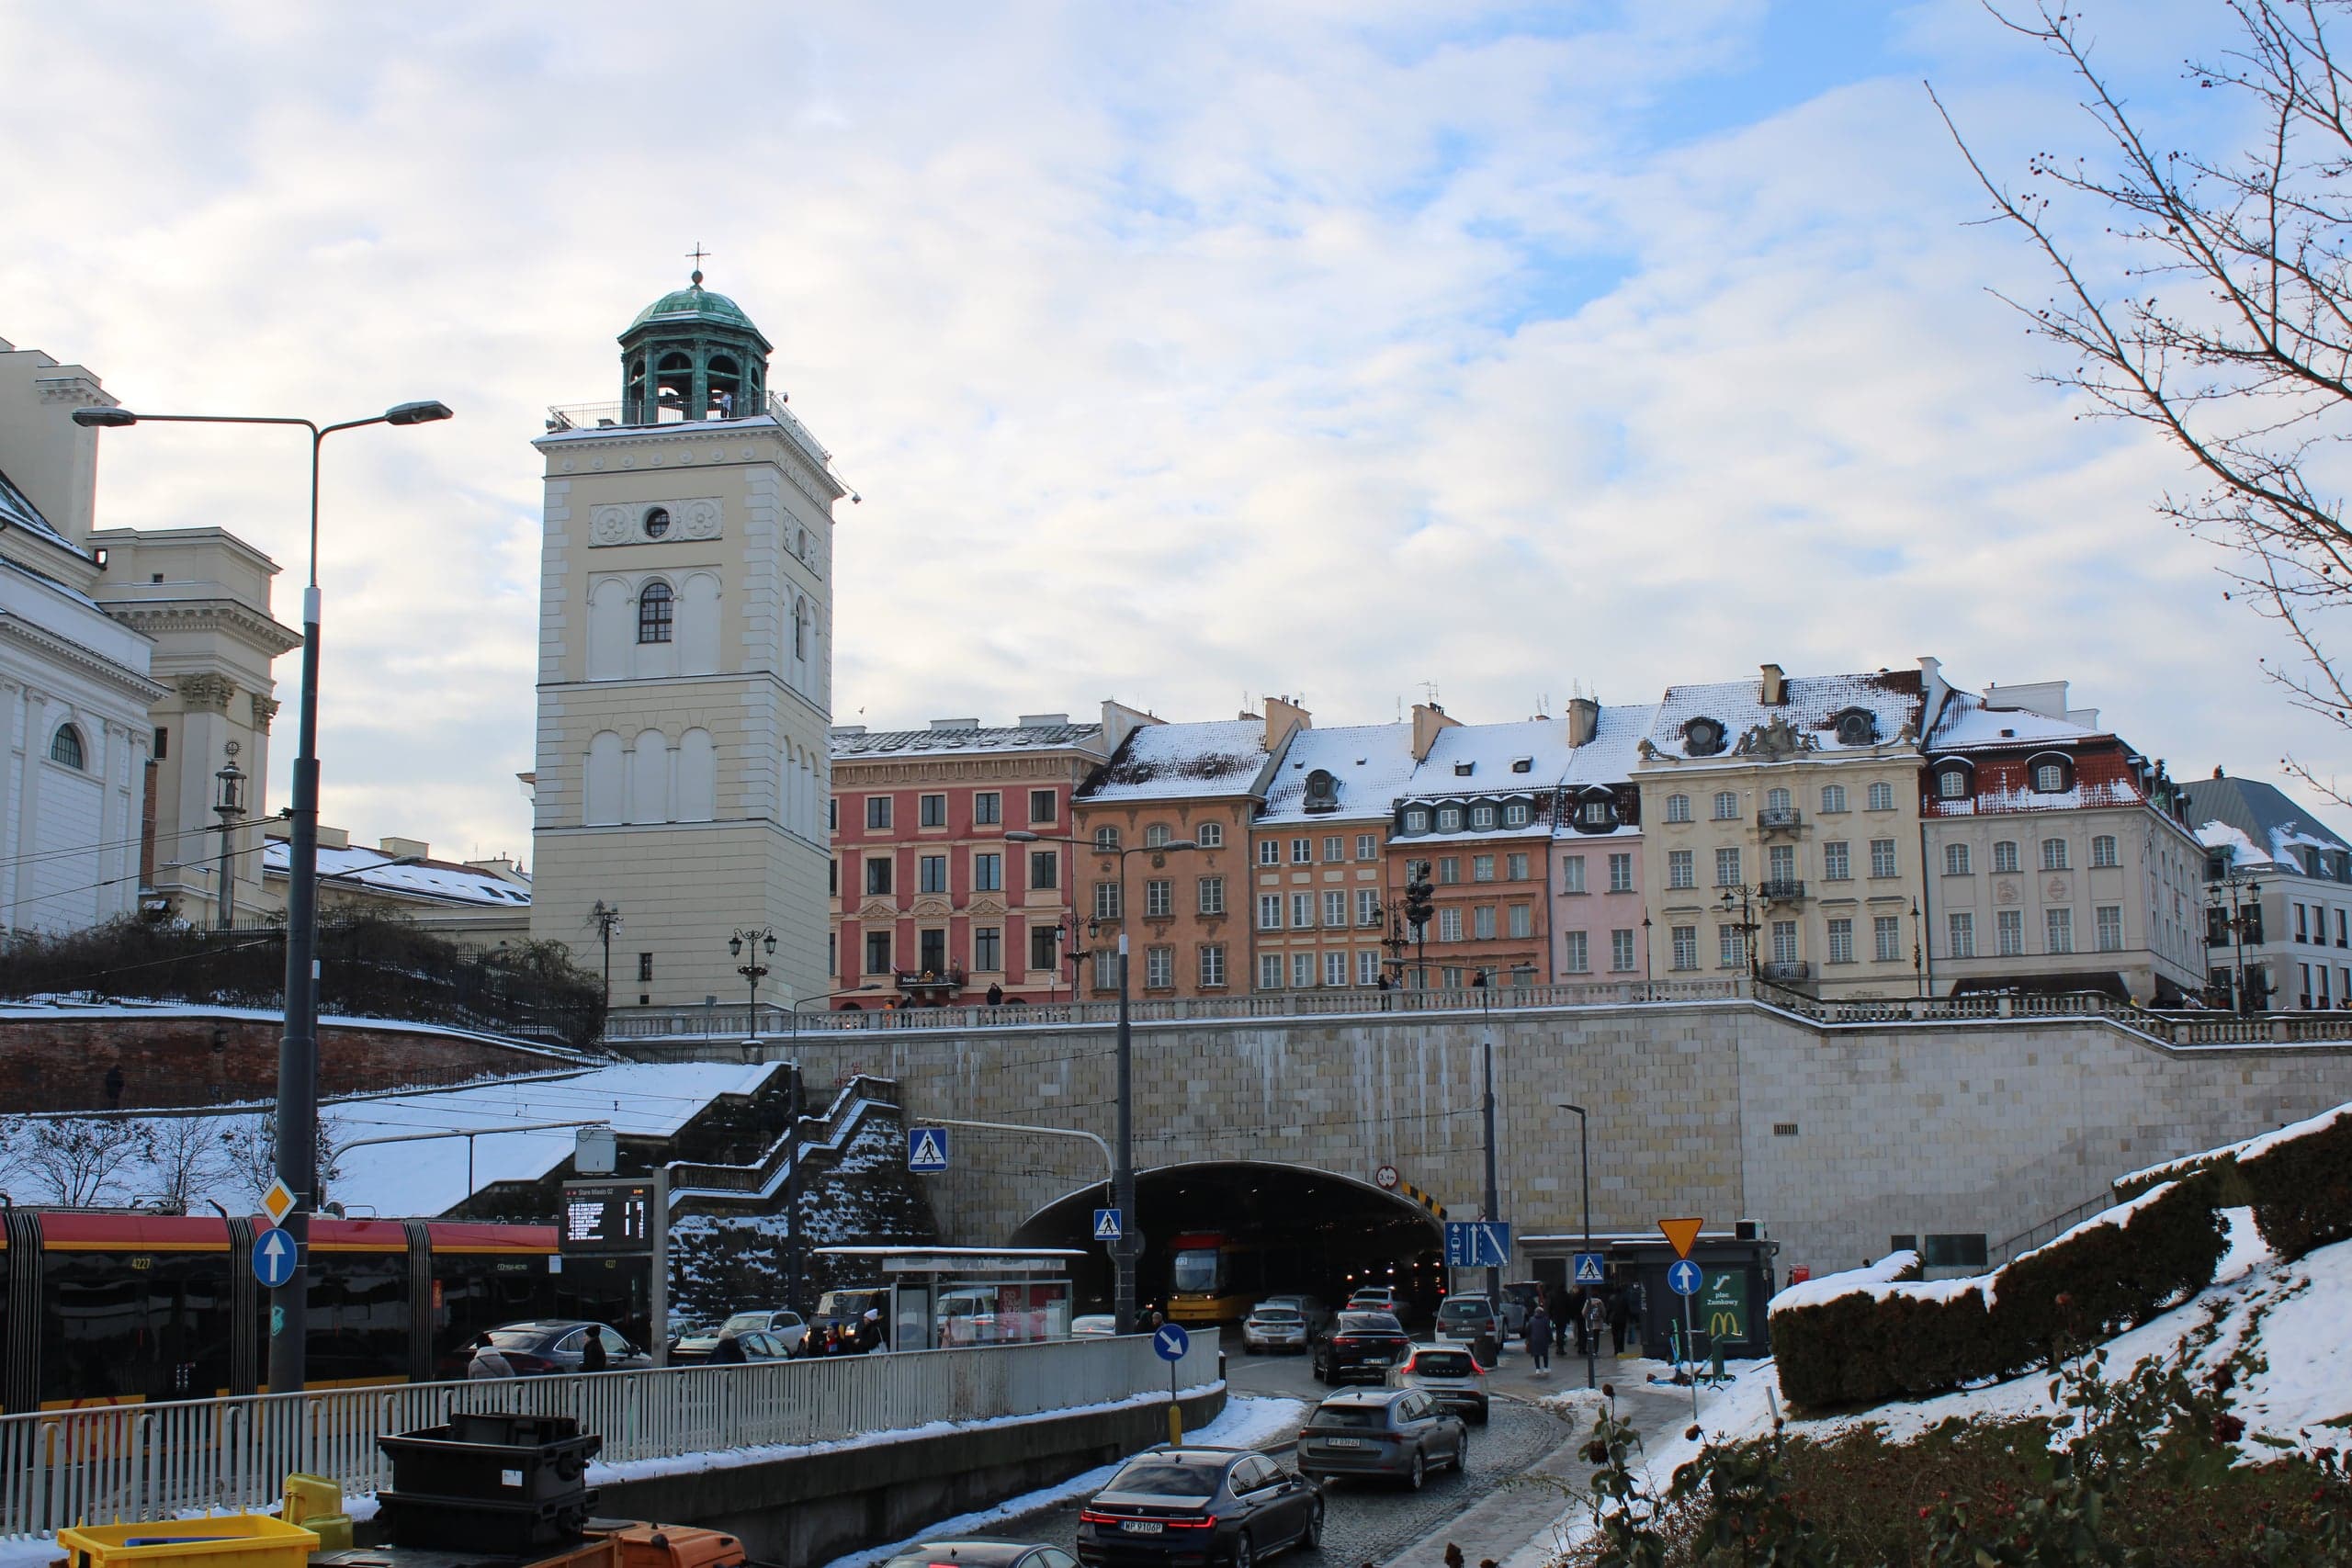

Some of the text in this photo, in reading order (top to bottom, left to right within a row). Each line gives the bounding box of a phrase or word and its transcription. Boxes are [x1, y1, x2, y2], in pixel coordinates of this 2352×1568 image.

[132, 1258, 151, 1269] 4227
[1715, 1292, 1730, 1300] plac
[1137, 1522, 1161, 1531] 9106P
